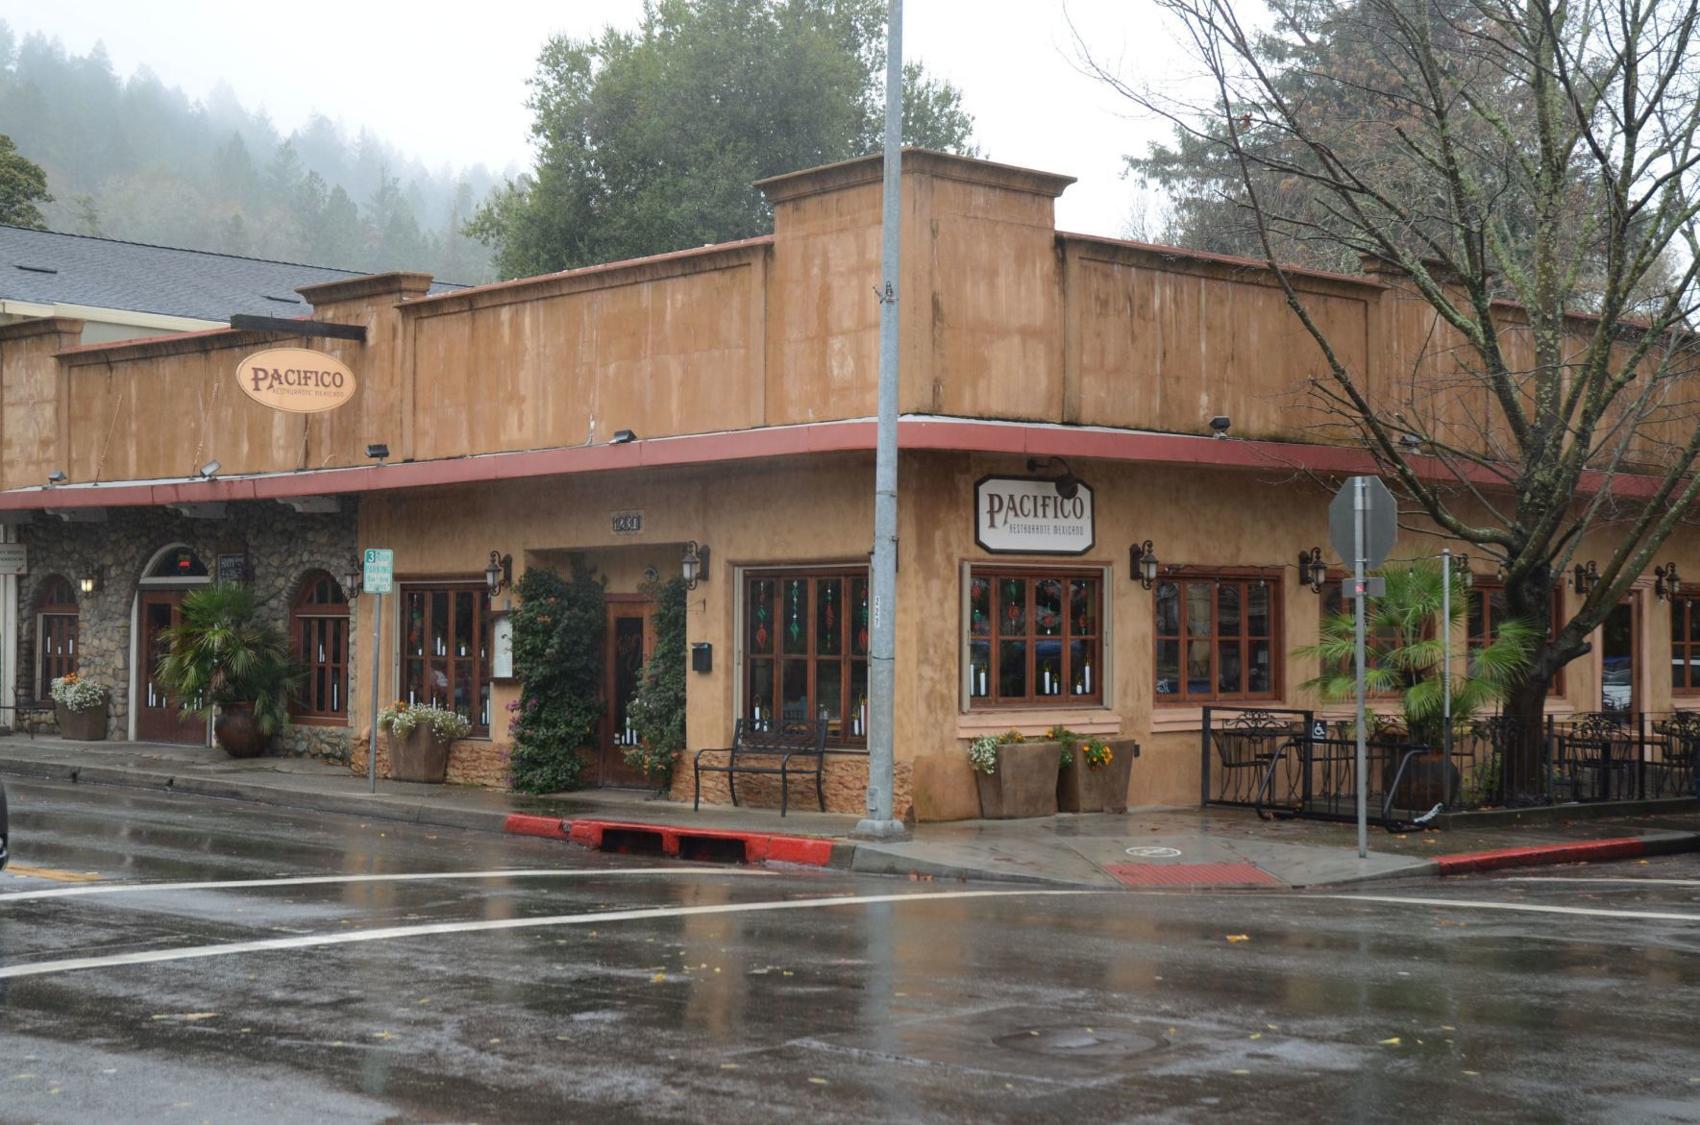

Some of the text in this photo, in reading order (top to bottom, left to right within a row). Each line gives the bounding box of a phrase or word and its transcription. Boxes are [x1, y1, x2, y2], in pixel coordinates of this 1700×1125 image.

[251, 367, 344, 391] PACIFICO
[986, 493, 1084, 528] PACIFICO
[1009, 523, 1084, 536] RESTAURANTE MEXICANO
[368, 551, 375, 562] 3
